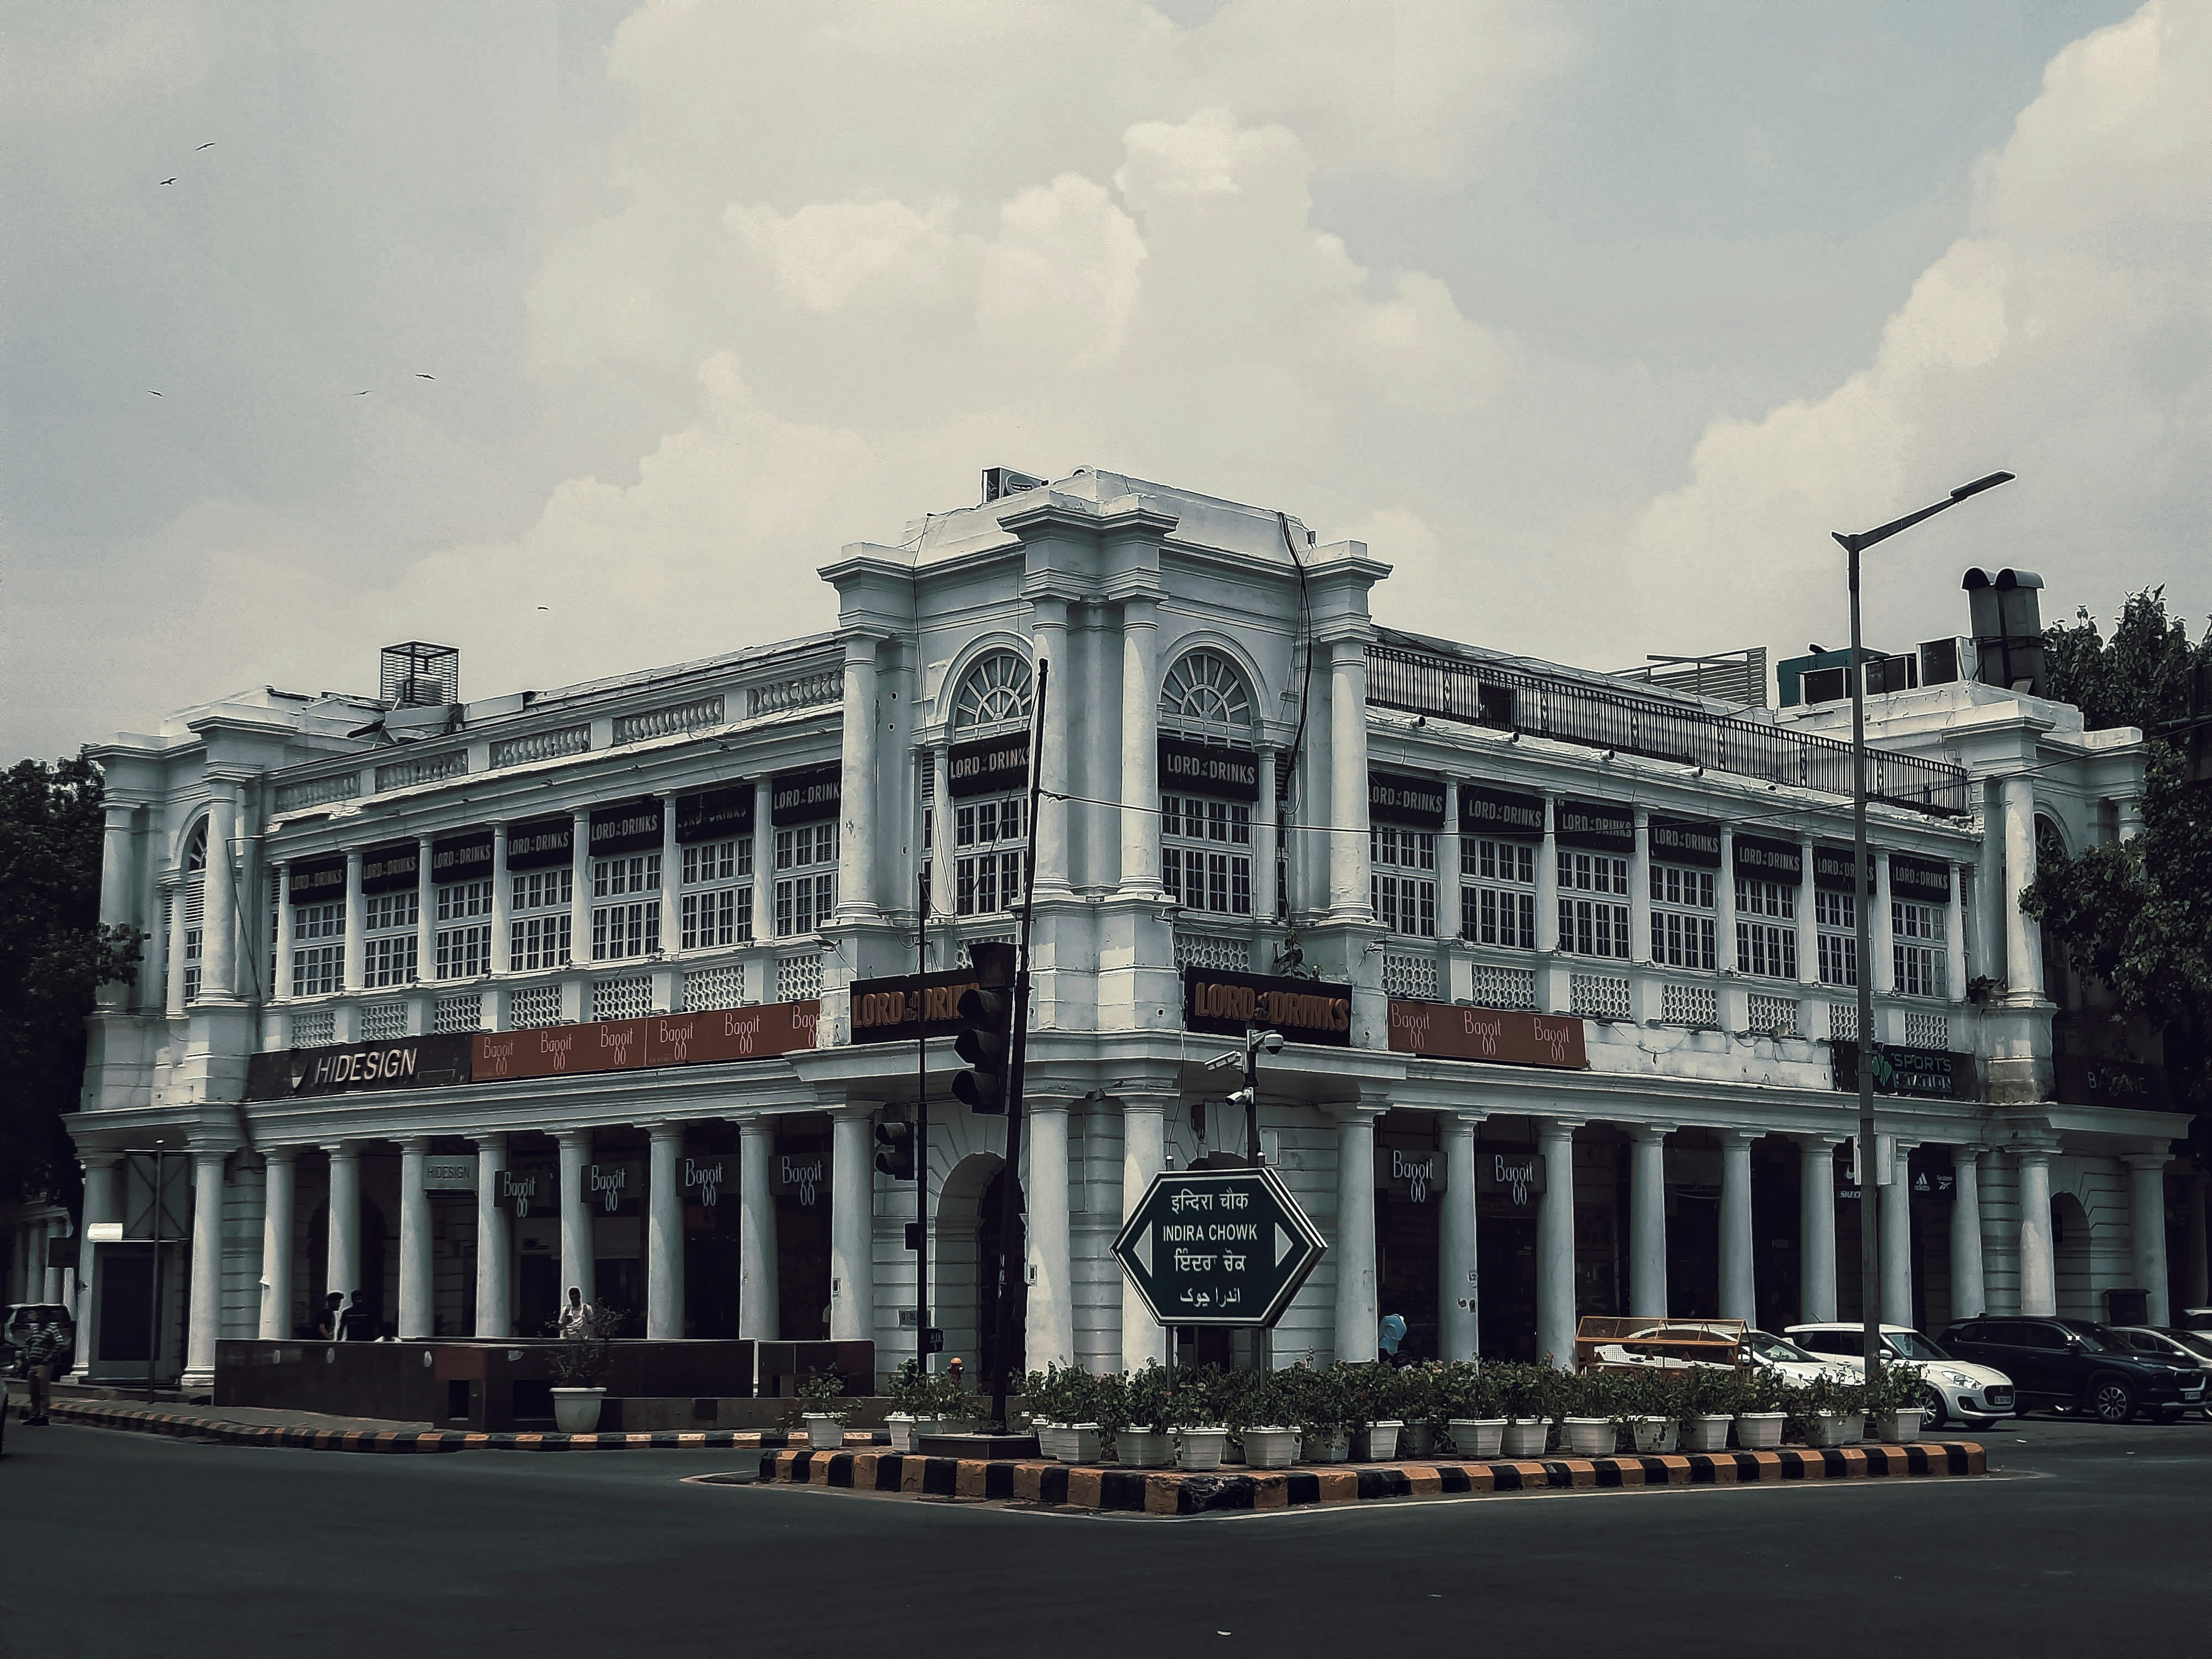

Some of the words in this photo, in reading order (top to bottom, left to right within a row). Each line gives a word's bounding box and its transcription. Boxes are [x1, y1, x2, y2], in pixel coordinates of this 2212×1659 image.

[950, 756, 980, 780] LORD
[1167, 753, 1200, 776] LORD
[1209, 760, 1255, 785] DRINKS
[774, 789, 800, 811] LORD
[807, 781, 839, 804] DRINK
[1369, 785, 1395, 806] ORD
[1403, 790, 1443, 813] DRINKS
[1469, 799, 1496, 820] LORD
[1503, 805, 1542, 828] DRINKS
[591, 822, 615, 841] LORD
[622, 814, 658, 836] DRINKS
[1562, 813, 1588, 831] LORD
[1655, 828, 1678, 847] LORD
[1685, 833, 1718, 853] DRINKS
[508, 837, 530, 857] LORD
[535, 831, 569, 852] DRINKS
[1739, 846, 1762, 865] LORD
[1768, 852, 1800, 872] DRINKS
[1817, 858, 1839, 875] LORD
[852, 991, 905, 1028] LORD
[1194, 982, 1255, 1021] LORD
[1269, 990, 1350, 1032] DRINKS
[660, 1020, 694, 1061] Baggit
[725, 1013, 761, 1054] Baggit
[1391, 1003, 1431, 1049] Baggit
[1464, 1010, 1501, 1056] Baggit
[1533, 1018, 1570, 1062] Baggit
[484, 1037, 514, 1075] Baggit
[540, 1031, 572, 1070] Baggit
[601, 1025, 634, 1065] Baggit
[1893, 1053, 1953, 1072] SPORTS
[314, 1047, 418, 1084] HIDESIGN
[503, 1171, 536, 1218] Baggit
[591, 1165, 626, 1212] Baggit
[685, 1159, 723, 1207] Baggit
[781, 1156, 823, 1207] Baggit
[1393, 1150, 1434, 1203] Baggit
[1495, 1154, 1534, 1205] Baggit
[1171, 1188, 1213, 1214] इन्दिरा
[1218, 1186, 1249, 1210] चौक
[1163, 1224, 1204, 1241] INDIRA
[1209, 1224, 1258, 1240] CHOWK
